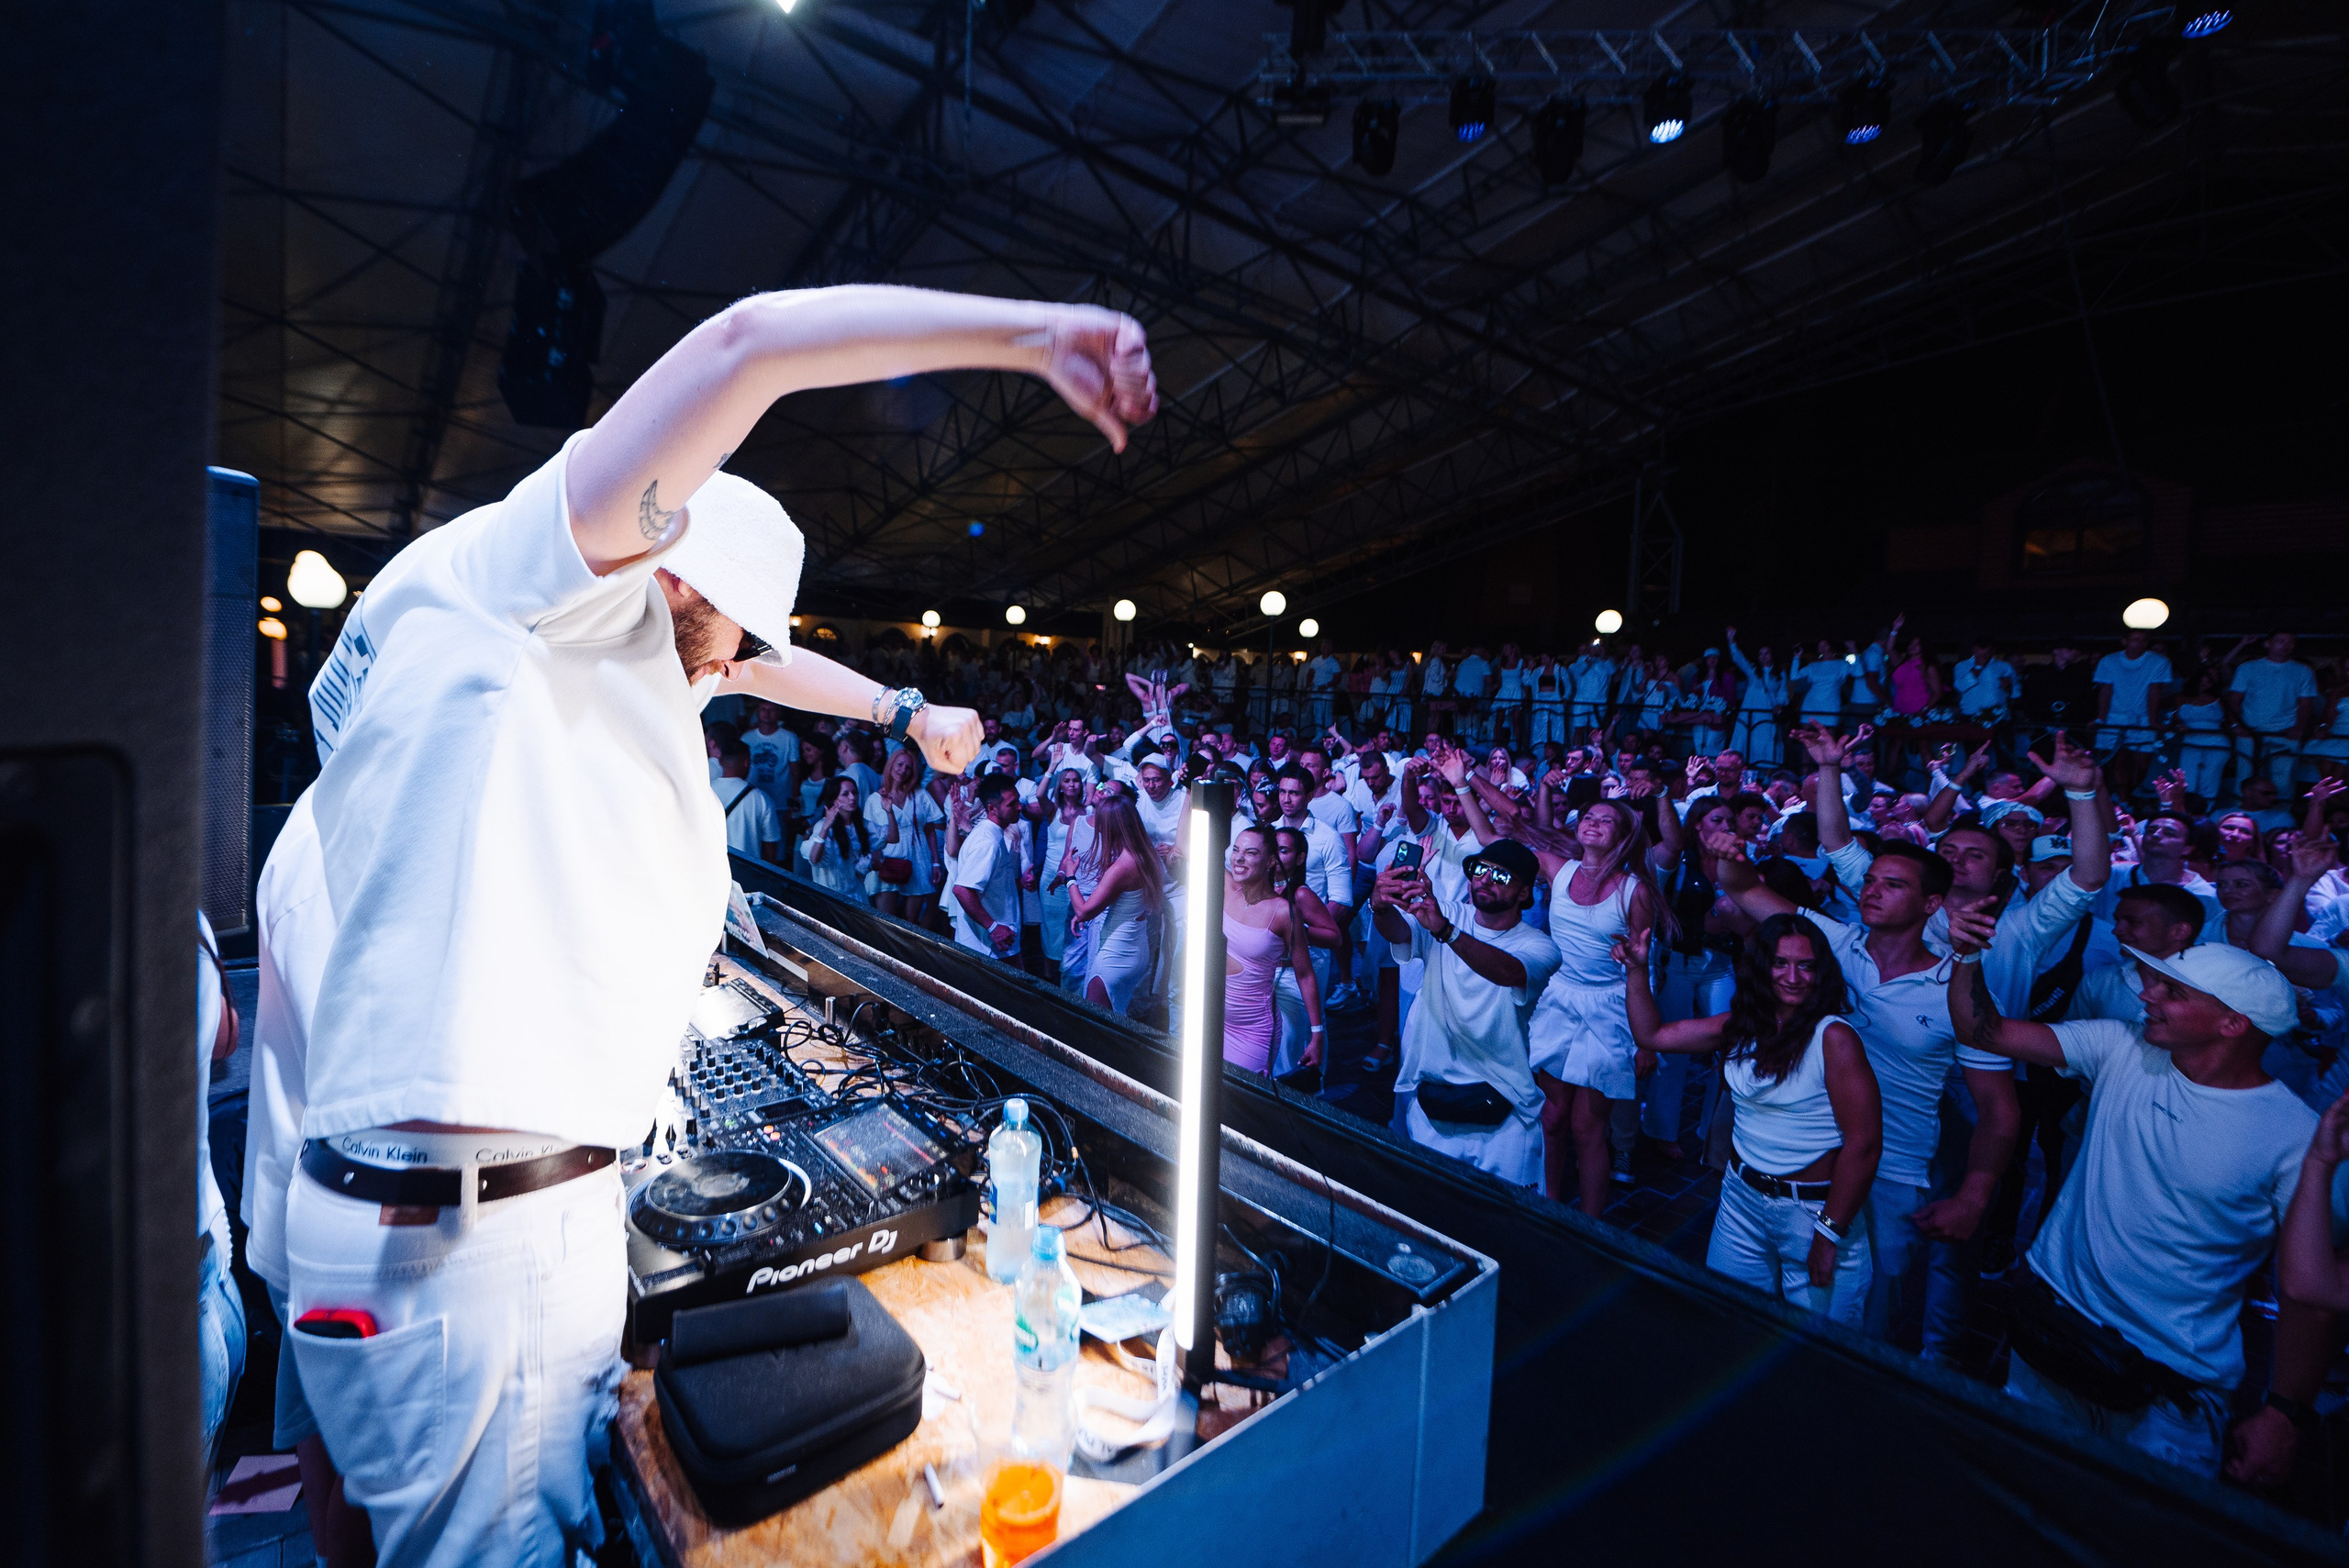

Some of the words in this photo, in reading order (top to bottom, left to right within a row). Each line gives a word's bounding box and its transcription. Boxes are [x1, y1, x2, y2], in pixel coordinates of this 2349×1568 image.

[342, 1136, 380, 1158] Calvin
[386, 1145, 428, 1163] Klein
[746, 1241, 863, 1294] Pioneer
[867, 1229, 898, 1254] DJ
